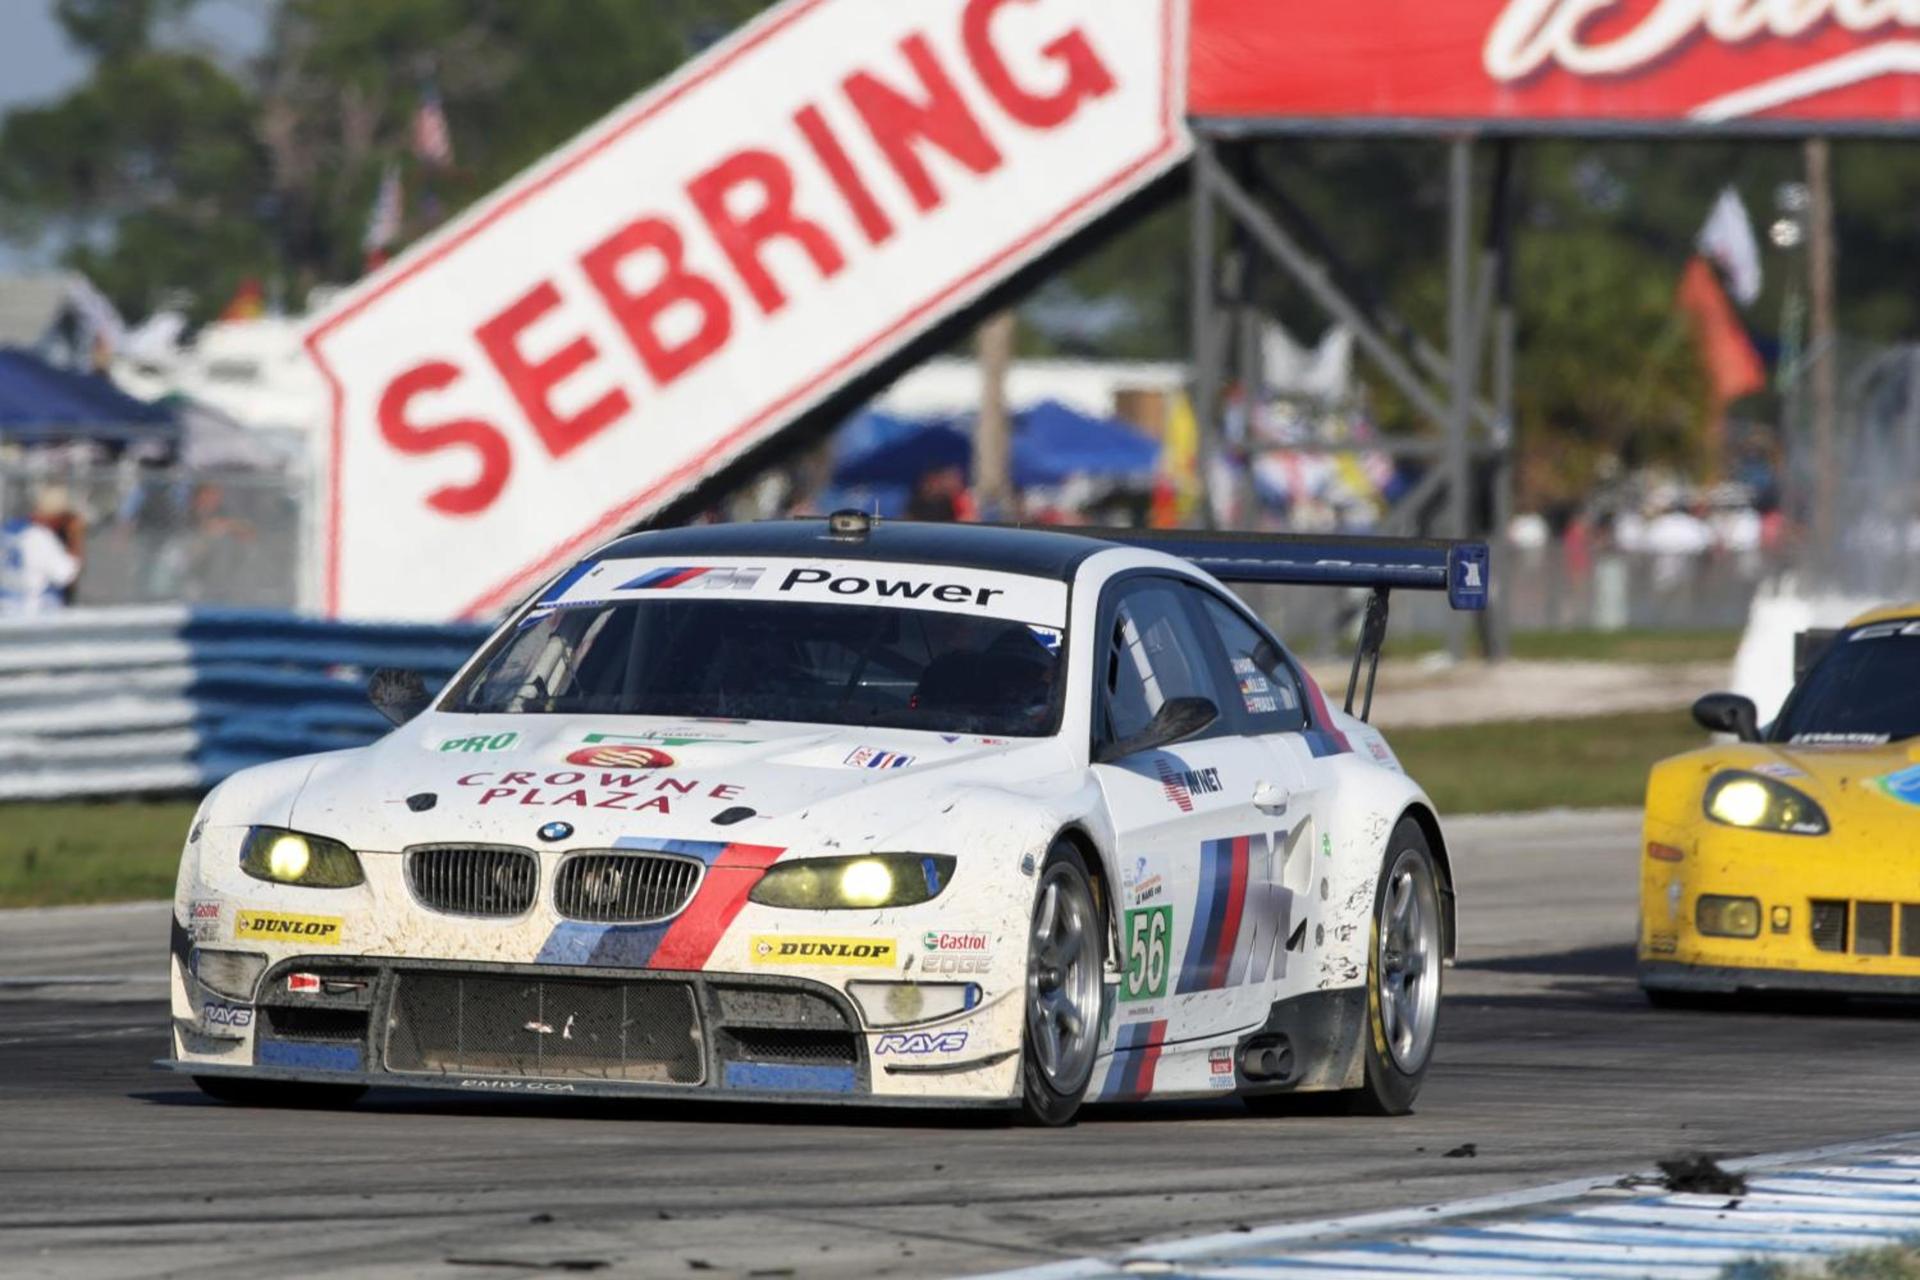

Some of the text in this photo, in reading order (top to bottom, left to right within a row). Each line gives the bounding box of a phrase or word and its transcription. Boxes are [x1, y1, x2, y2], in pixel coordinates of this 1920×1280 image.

[377, 0, 1118, 518] SEBRING
[779, 568, 1004, 606] Power
[440, 732, 518, 752] PRO
[457, 771, 745, 800] CROWNE
[478, 787, 671, 814] PLAZA
[251, 918, 337, 936] DUNLOP
[778, 942, 890, 958] DUNLOP
[939, 933, 988, 950] Castrol
[1127, 908, 1167, 996] 56
[921, 955, 992, 974] EDGE
[204, 1003, 252, 1026] RAYS
[875, 1031, 968, 1054] RAYS
